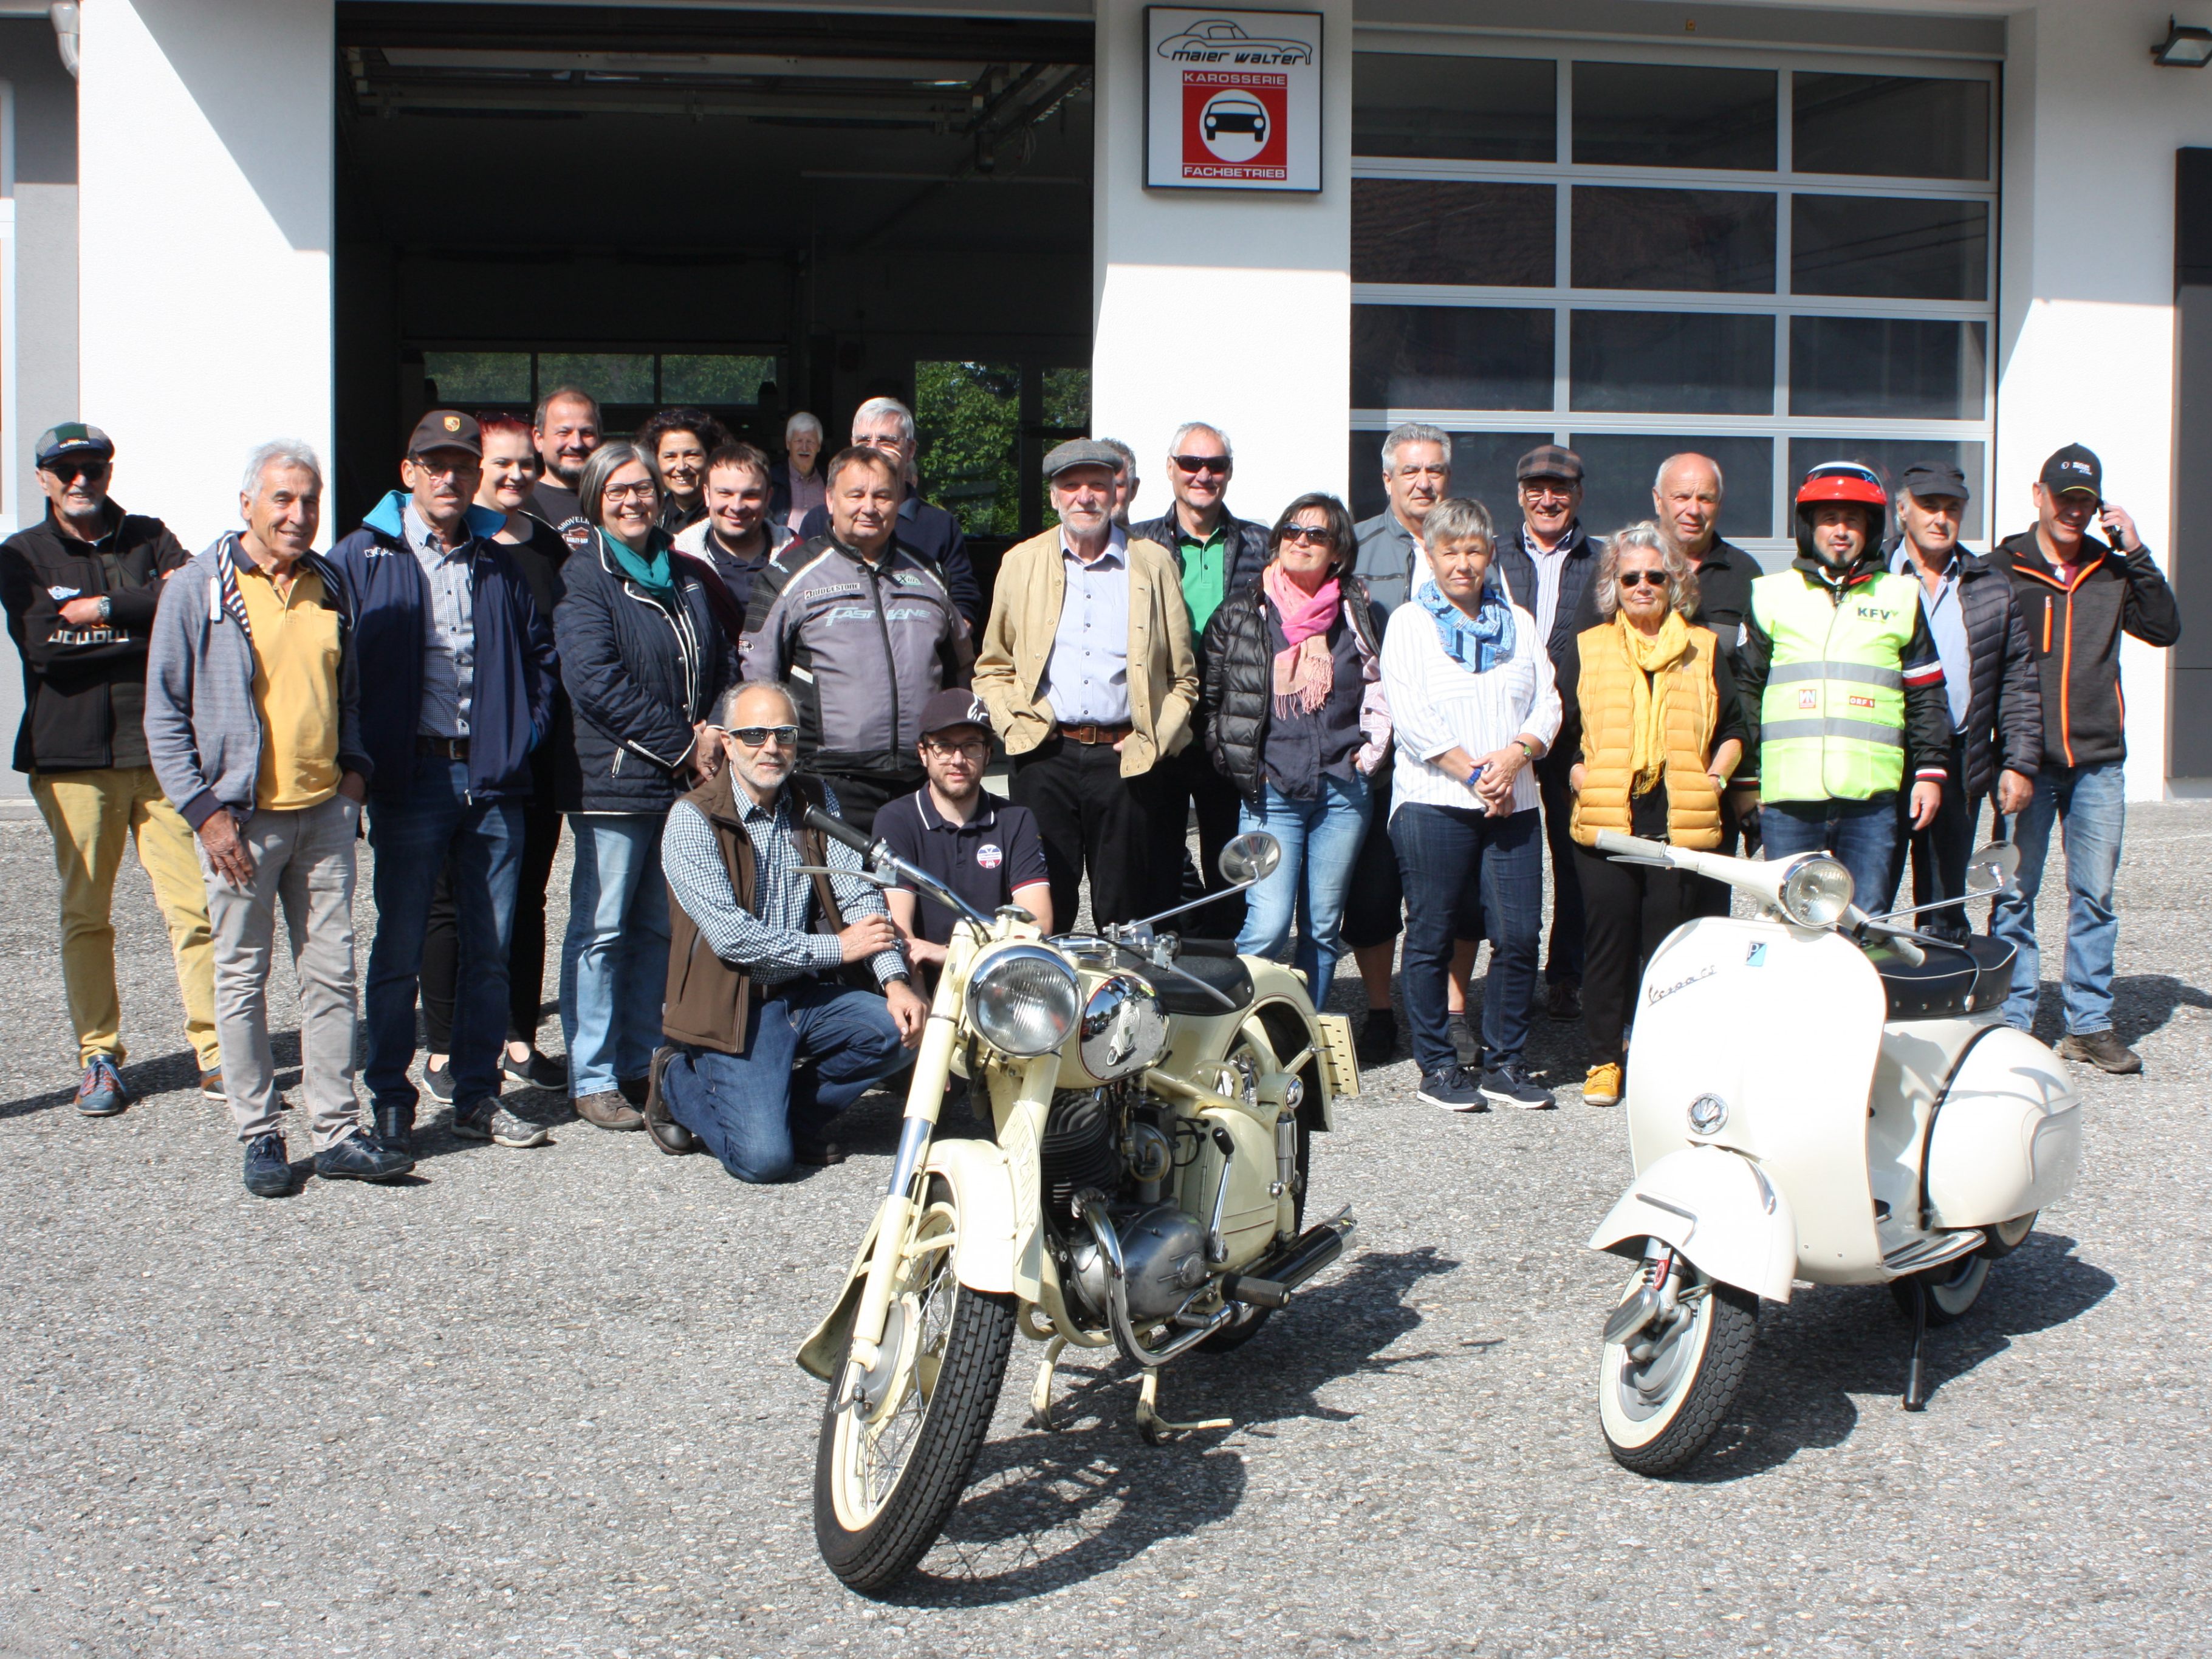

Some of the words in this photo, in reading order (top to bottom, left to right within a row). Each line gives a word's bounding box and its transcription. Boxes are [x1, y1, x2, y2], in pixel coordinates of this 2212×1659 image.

[1184, 73, 1286, 86] KAROSSERIE
[1184, 166, 1286, 179] FACHBETRIEB
[805, 583, 860, 599] BRIDGESTONE
[824, 607, 876, 628] FAST
[886, 608, 931, 620] LANE
[1857, 607, 1890, 620] KFV
[1850, 697, 1867, 706] ORF
[1748, 943, 1759, 957] P
